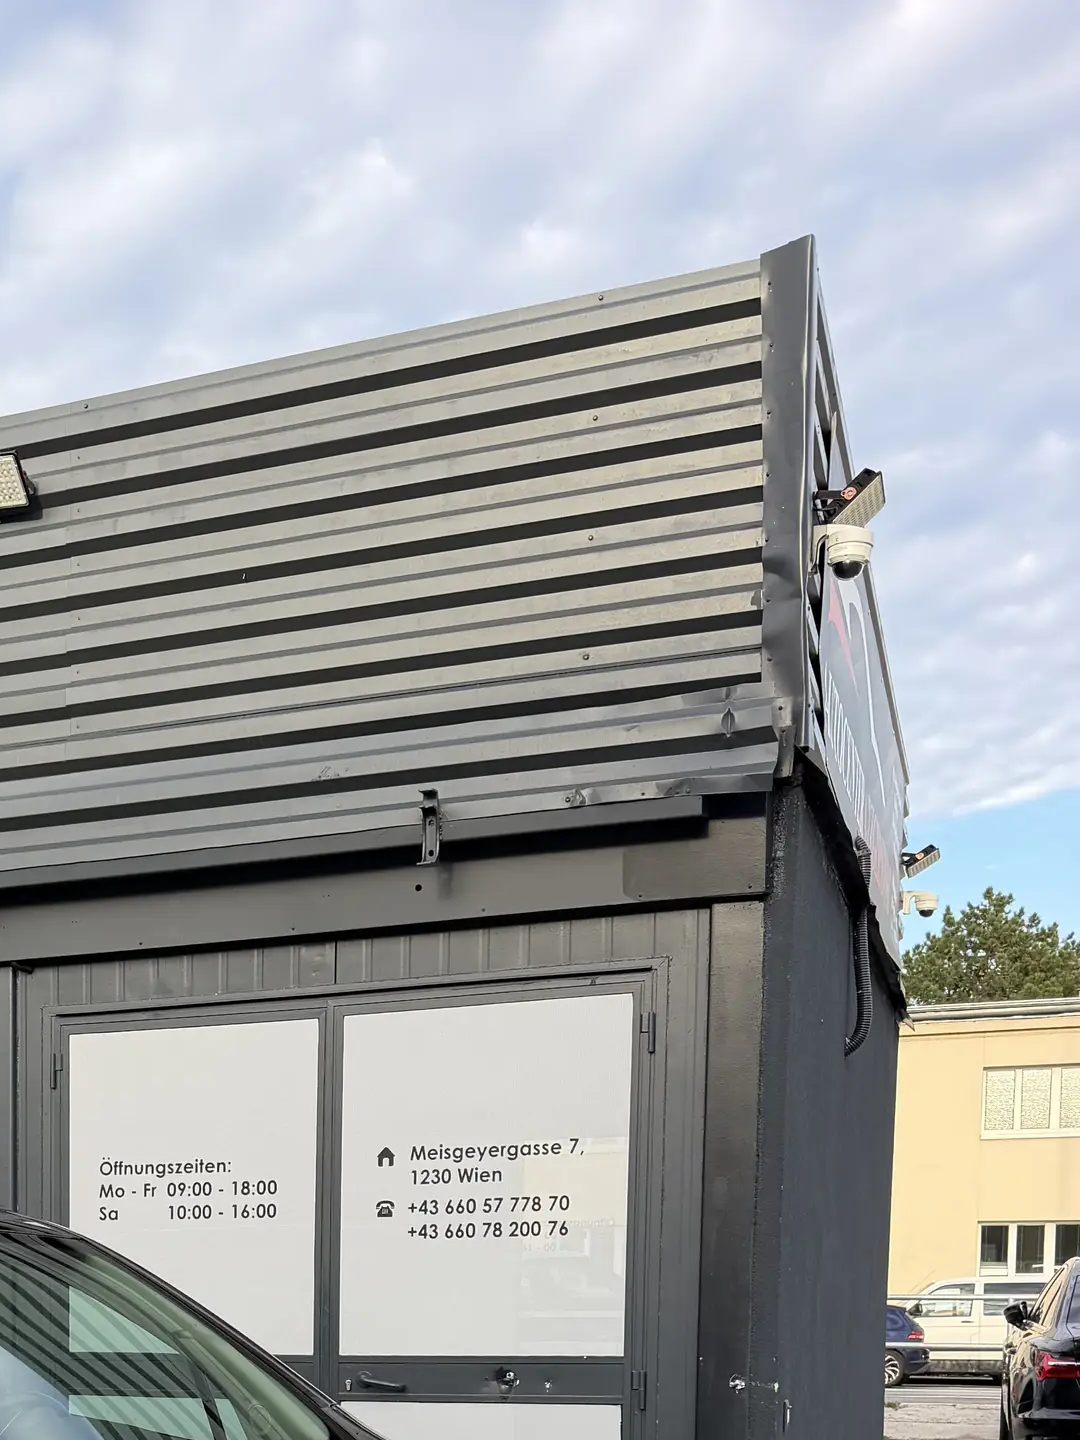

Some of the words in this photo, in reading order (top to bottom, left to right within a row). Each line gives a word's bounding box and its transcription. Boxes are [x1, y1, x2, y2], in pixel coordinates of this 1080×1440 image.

[410, 1142, 562, 1164] Meisgeyergasse
[569, 1138, 584, 1156] 7,
[99, 1156, 232, 1179] Öffnungszeiten:
[411, 1168, 452, 1185] 1230
[457, 1166, 502, 1184] Wien
[99, 1183, 126, 1199] Mo
[143, 1182, 157, 1198] Fr
[166, 1181, 213, 1198] 09:00
[231, 1179, 278, 1196] 18:00
[99, 1206, 119, 1221] Sa
[168, 1204, 212, 1220] 10:00
[231, 1203, 277, 1219] 16:00
[407, 1199, 439, 1216] +43
[445, 1198, 477, 1215] 660
[482, 1197, 504, 1214] 57
[510, 1195, 542, 1213] 778
[548, 1194, 570, 1211] 70
[407, 1223, 439, 1240] +43
[444, 1222, 476, 1239] 660
[482, 1221, 503, 1238] 78
[508, 1220, 542, 1238] 200
[547, 1220, 569, 1237] 76
